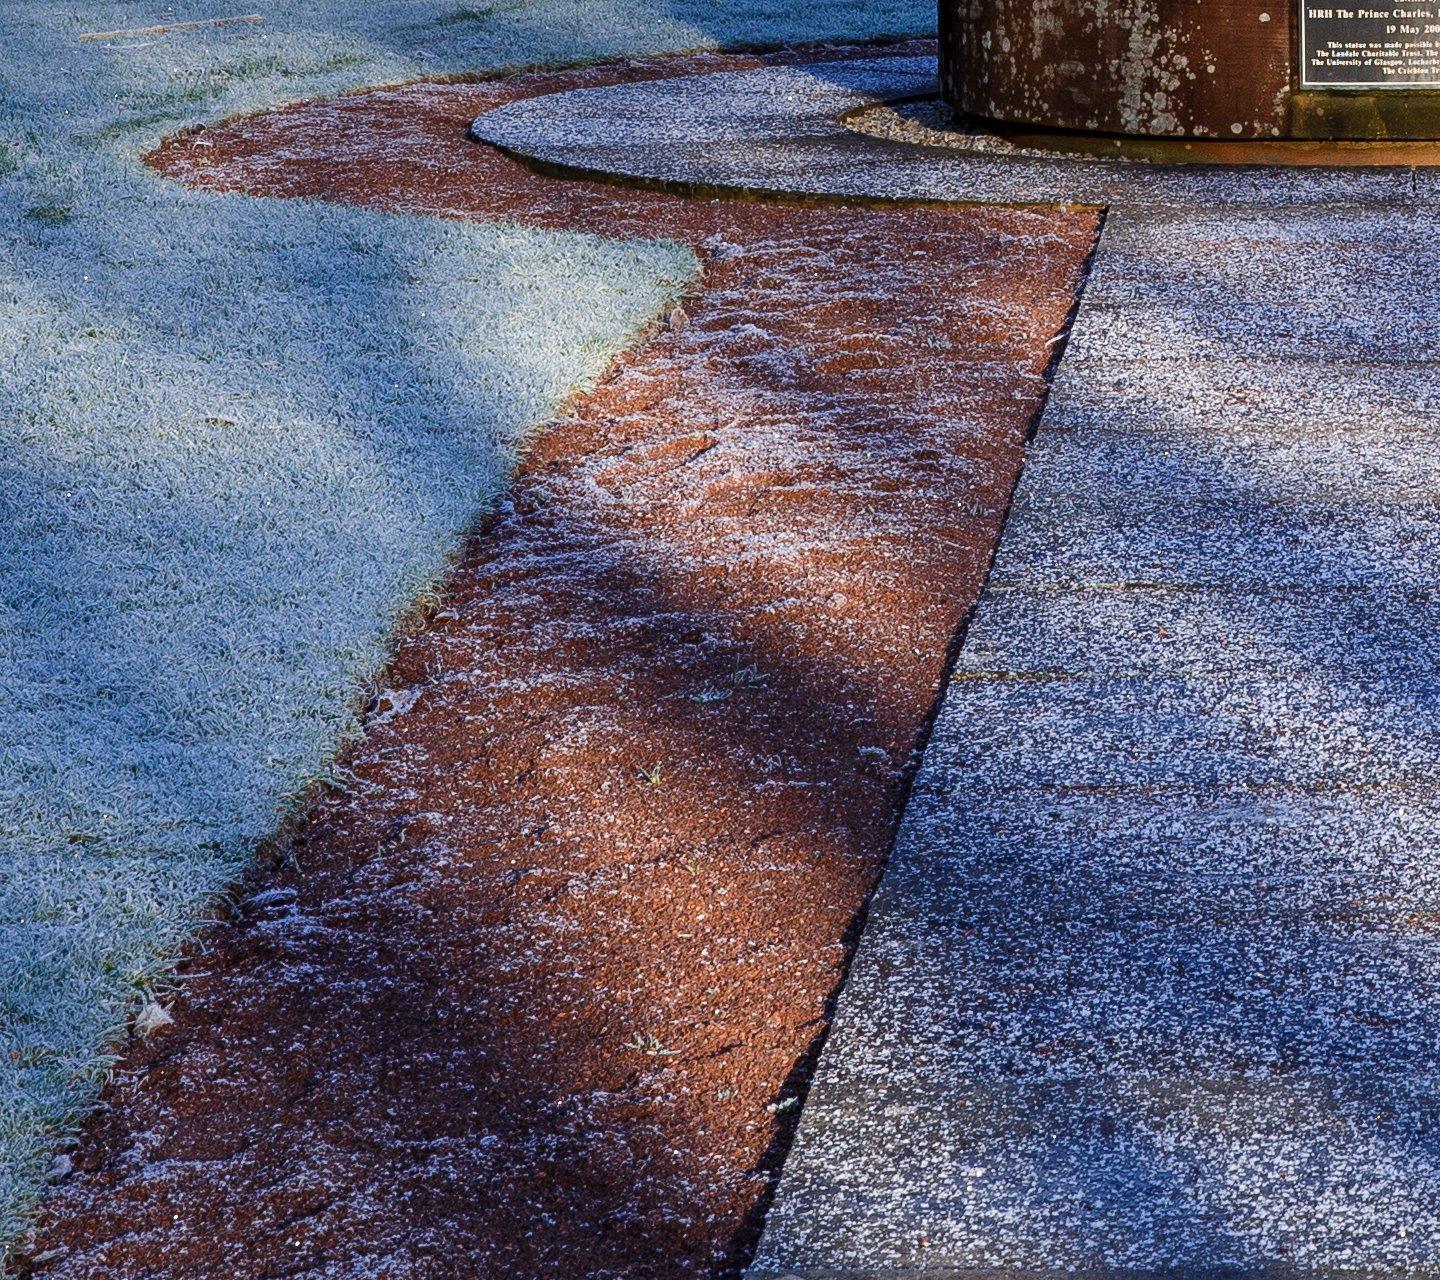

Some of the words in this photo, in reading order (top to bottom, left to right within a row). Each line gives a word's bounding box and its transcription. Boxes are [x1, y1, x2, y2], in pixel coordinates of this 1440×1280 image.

[1308, 9, 1333, 19] HRH
[1336, 9, 1354, 18] The
[1358, 9, 1389, 18] Prince
[1392, 8, 1434, 18] Charles,
[1386, 24, 1396, 34] 19
[1400, 24, 1420, 35] May
